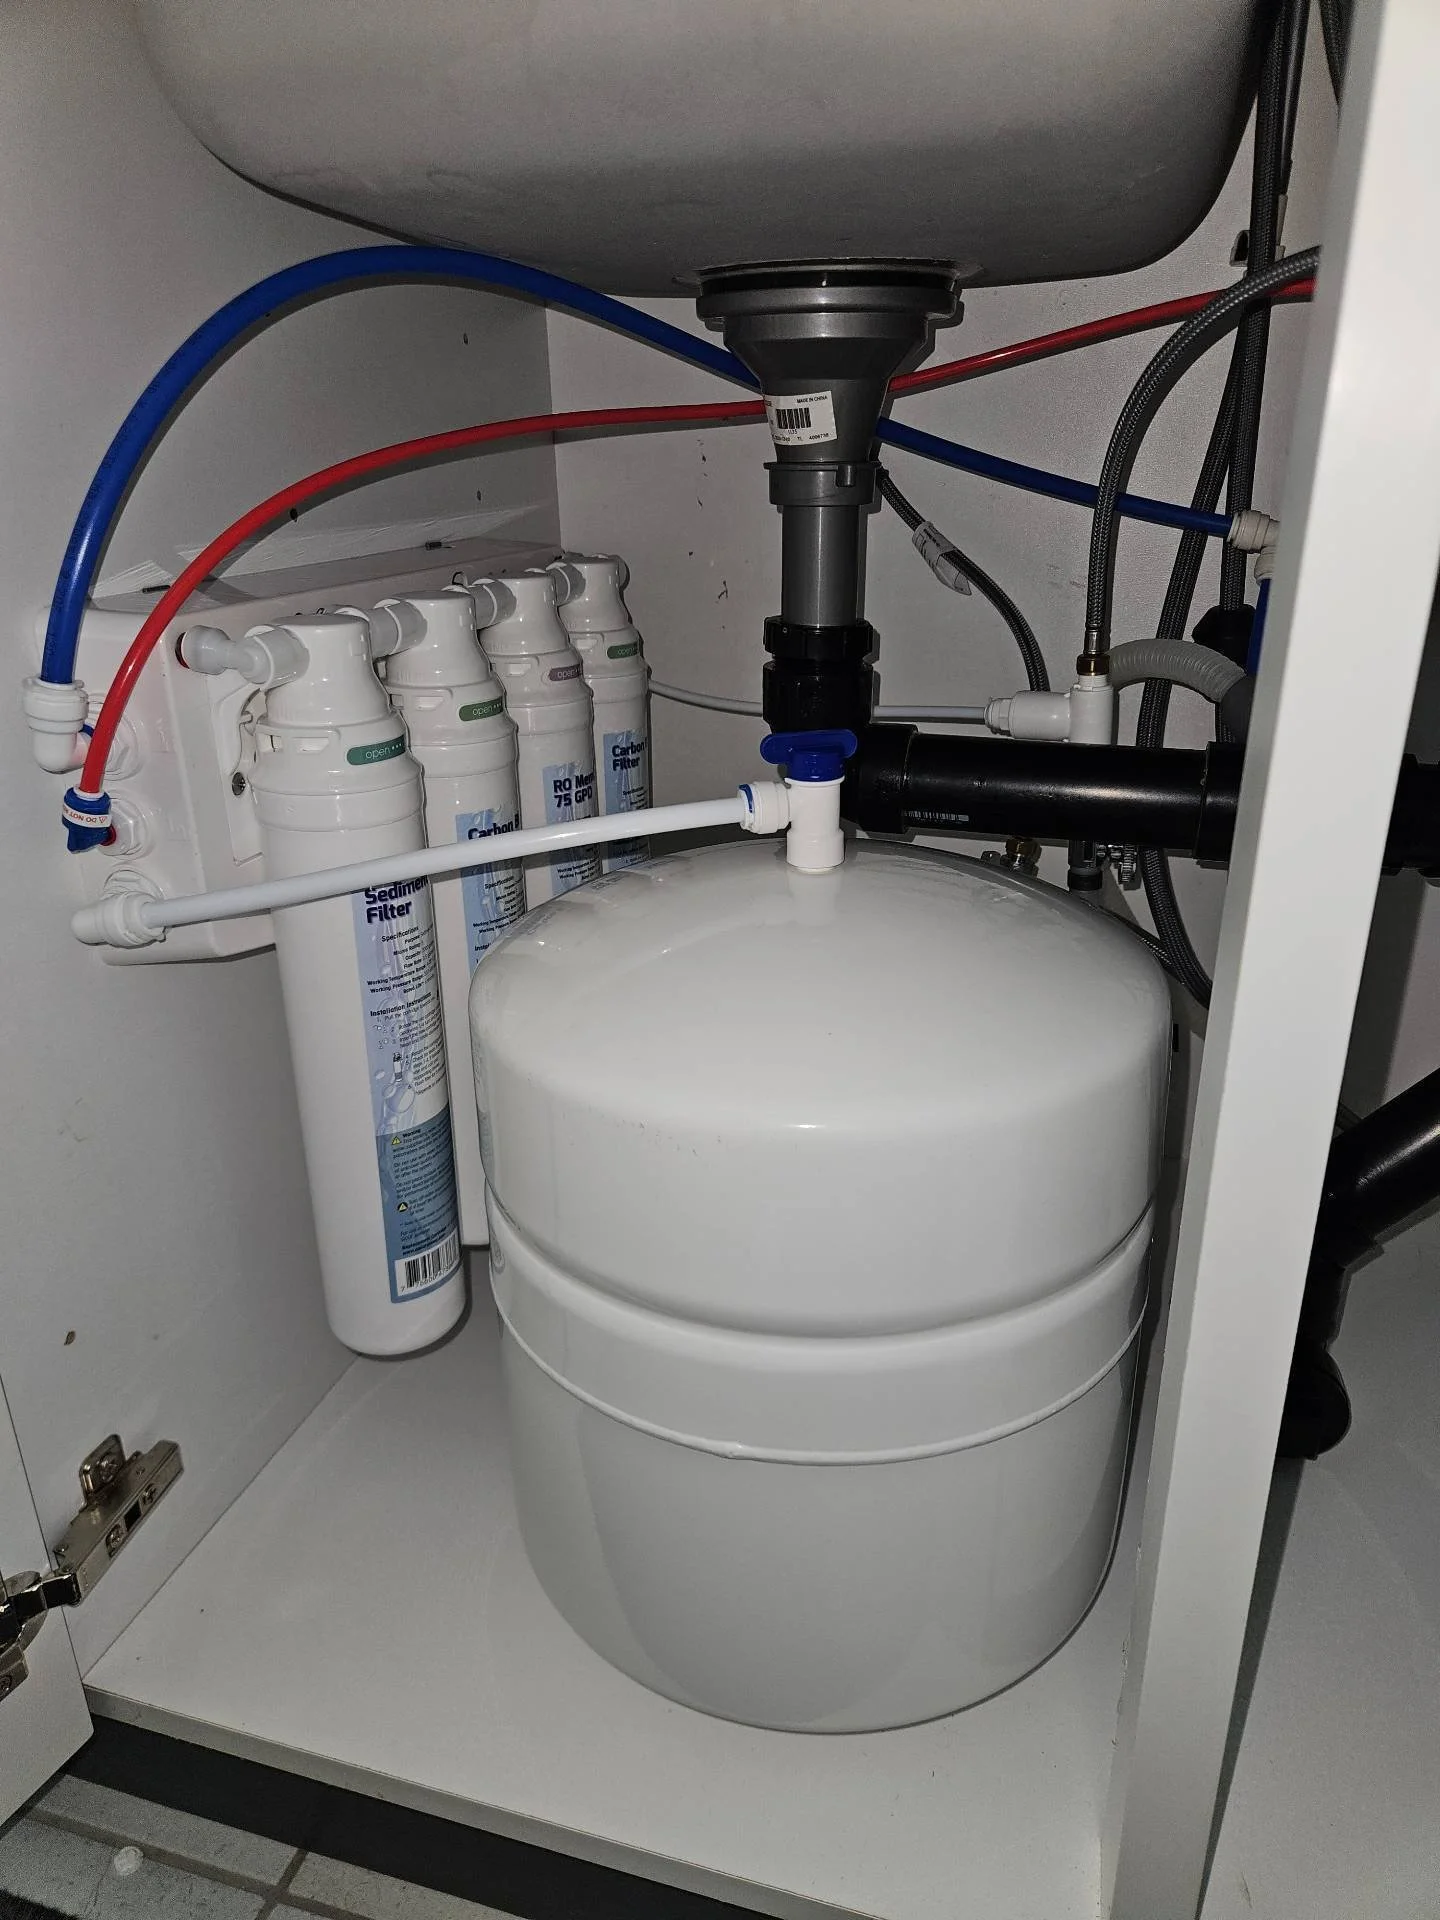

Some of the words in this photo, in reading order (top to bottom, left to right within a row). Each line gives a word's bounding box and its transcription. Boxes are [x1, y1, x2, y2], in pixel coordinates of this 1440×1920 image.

[472, 704, 493, 717] open
[365, 746, 391, 760] open
[612, 741, 644, 758] Carbon
[613, 757, 640, 771] Filter
[553, 778, 572, 793] RO
[554, 793, 572, 808] 75
[575, 786, 593, 804] GPD
[366, 901, 412, 924] Filter
[370, 1003, 405, 1017] Installation
